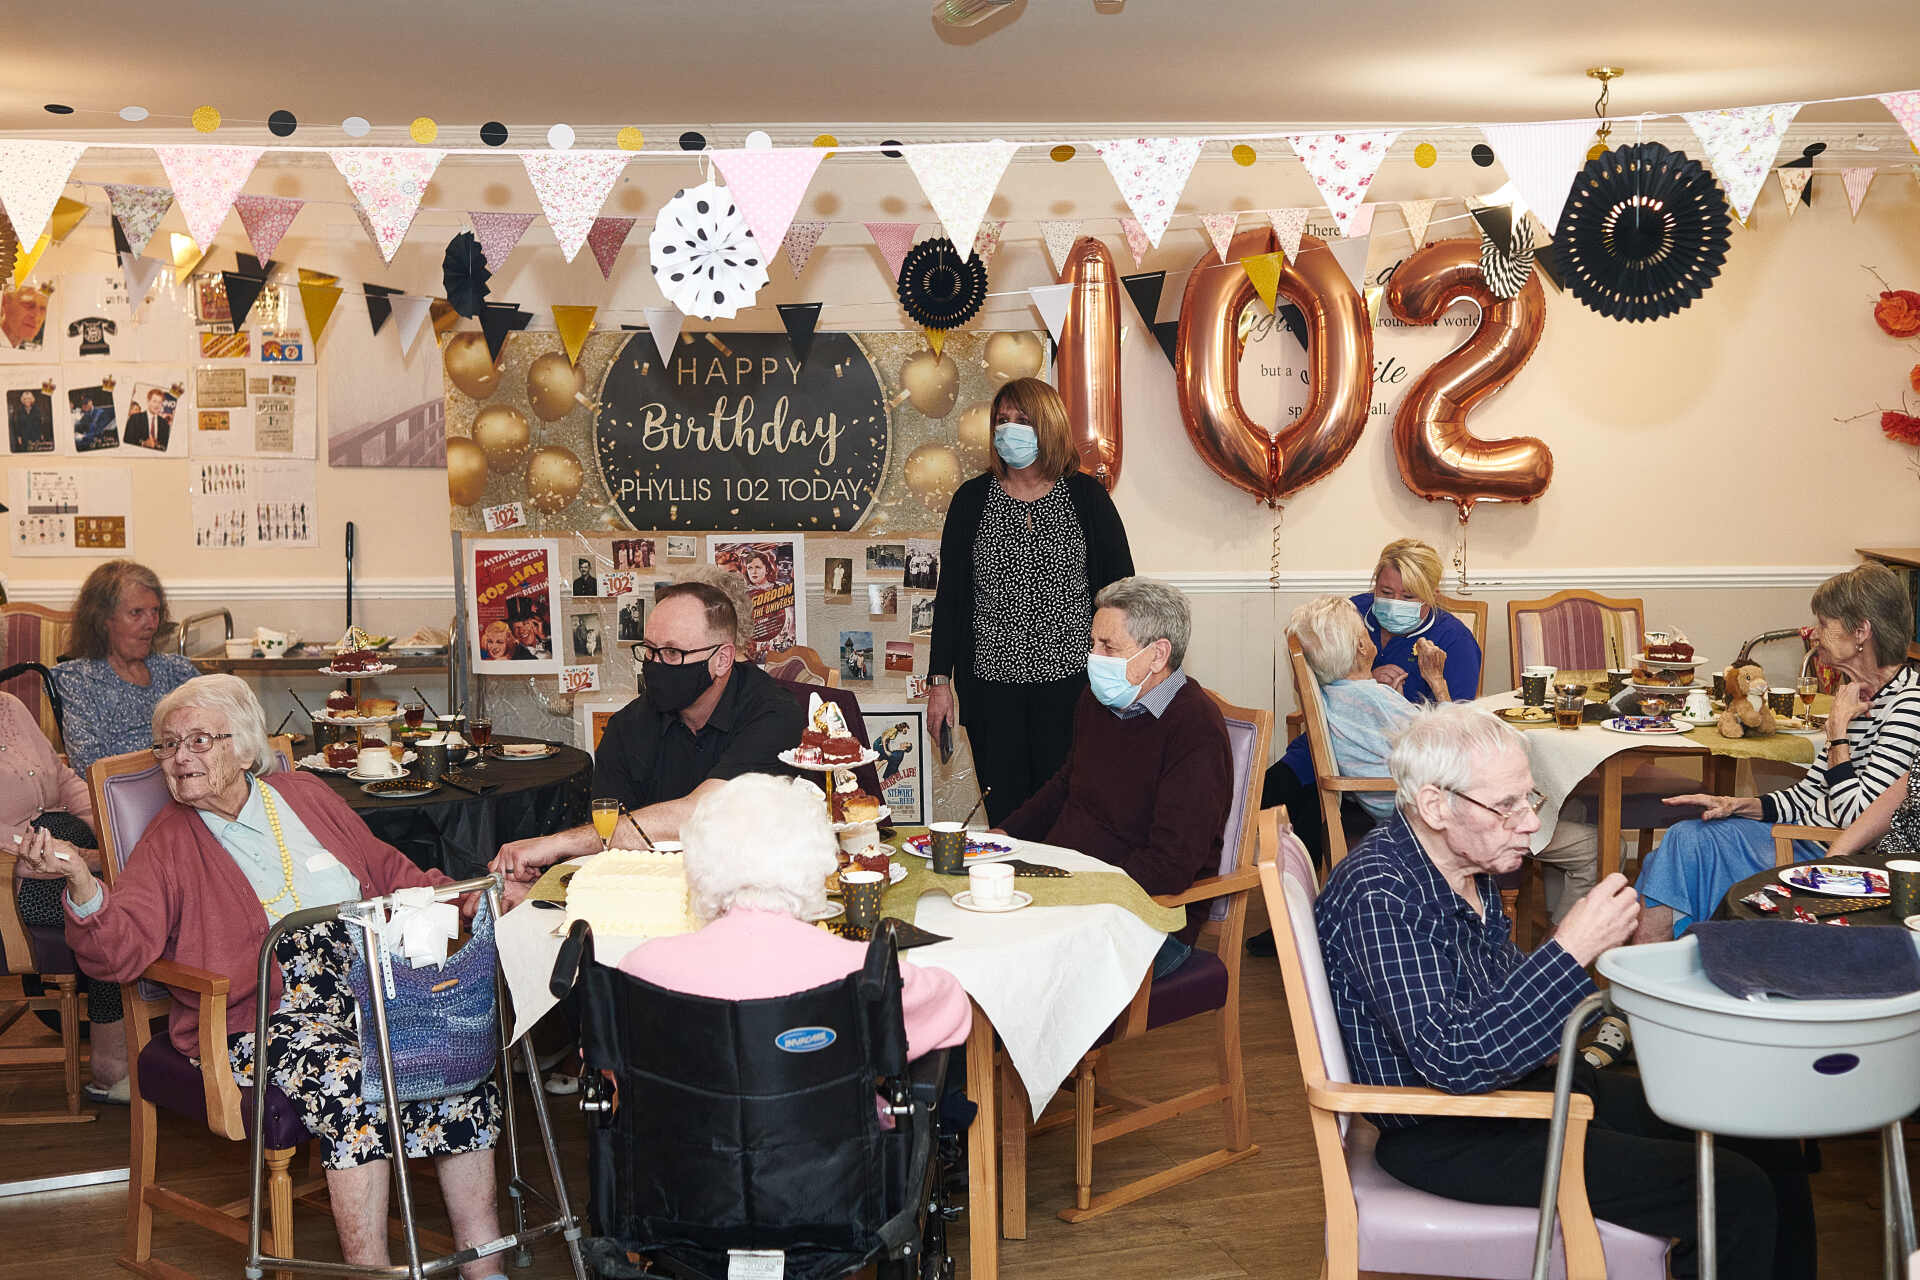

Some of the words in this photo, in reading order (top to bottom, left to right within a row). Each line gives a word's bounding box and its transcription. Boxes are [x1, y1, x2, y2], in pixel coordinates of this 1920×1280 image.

[1305, 223, 1341, 237] There
[1444, 313, 1481, 328] world
[677, 356, 802, 385] HAPPY
[1260, 363, 1281, 377] but
[1285, 367, 1293, 377] a
[1370, 404, 1391, 416] all.
[639, 395, 846, 466] Birthday
[621, 478, 712, 501] PHYLLIS
[722, 478, 769, 501] 102
[777, 478, 864, 501] TODAY
[493, 508, 515, 526] 102
[508, 549, 544, 568] ROGERS
[478, 580, 509, 605] TOP
[509, 560, 545, 587] HAT
[607, 575, 630, 592] 102
[751, 583, 793, 608] GORDON
[753, 608, 765, 620] THE
[568, 671, 589, 688] 102
[887, 788, 914, 798] STEWART
